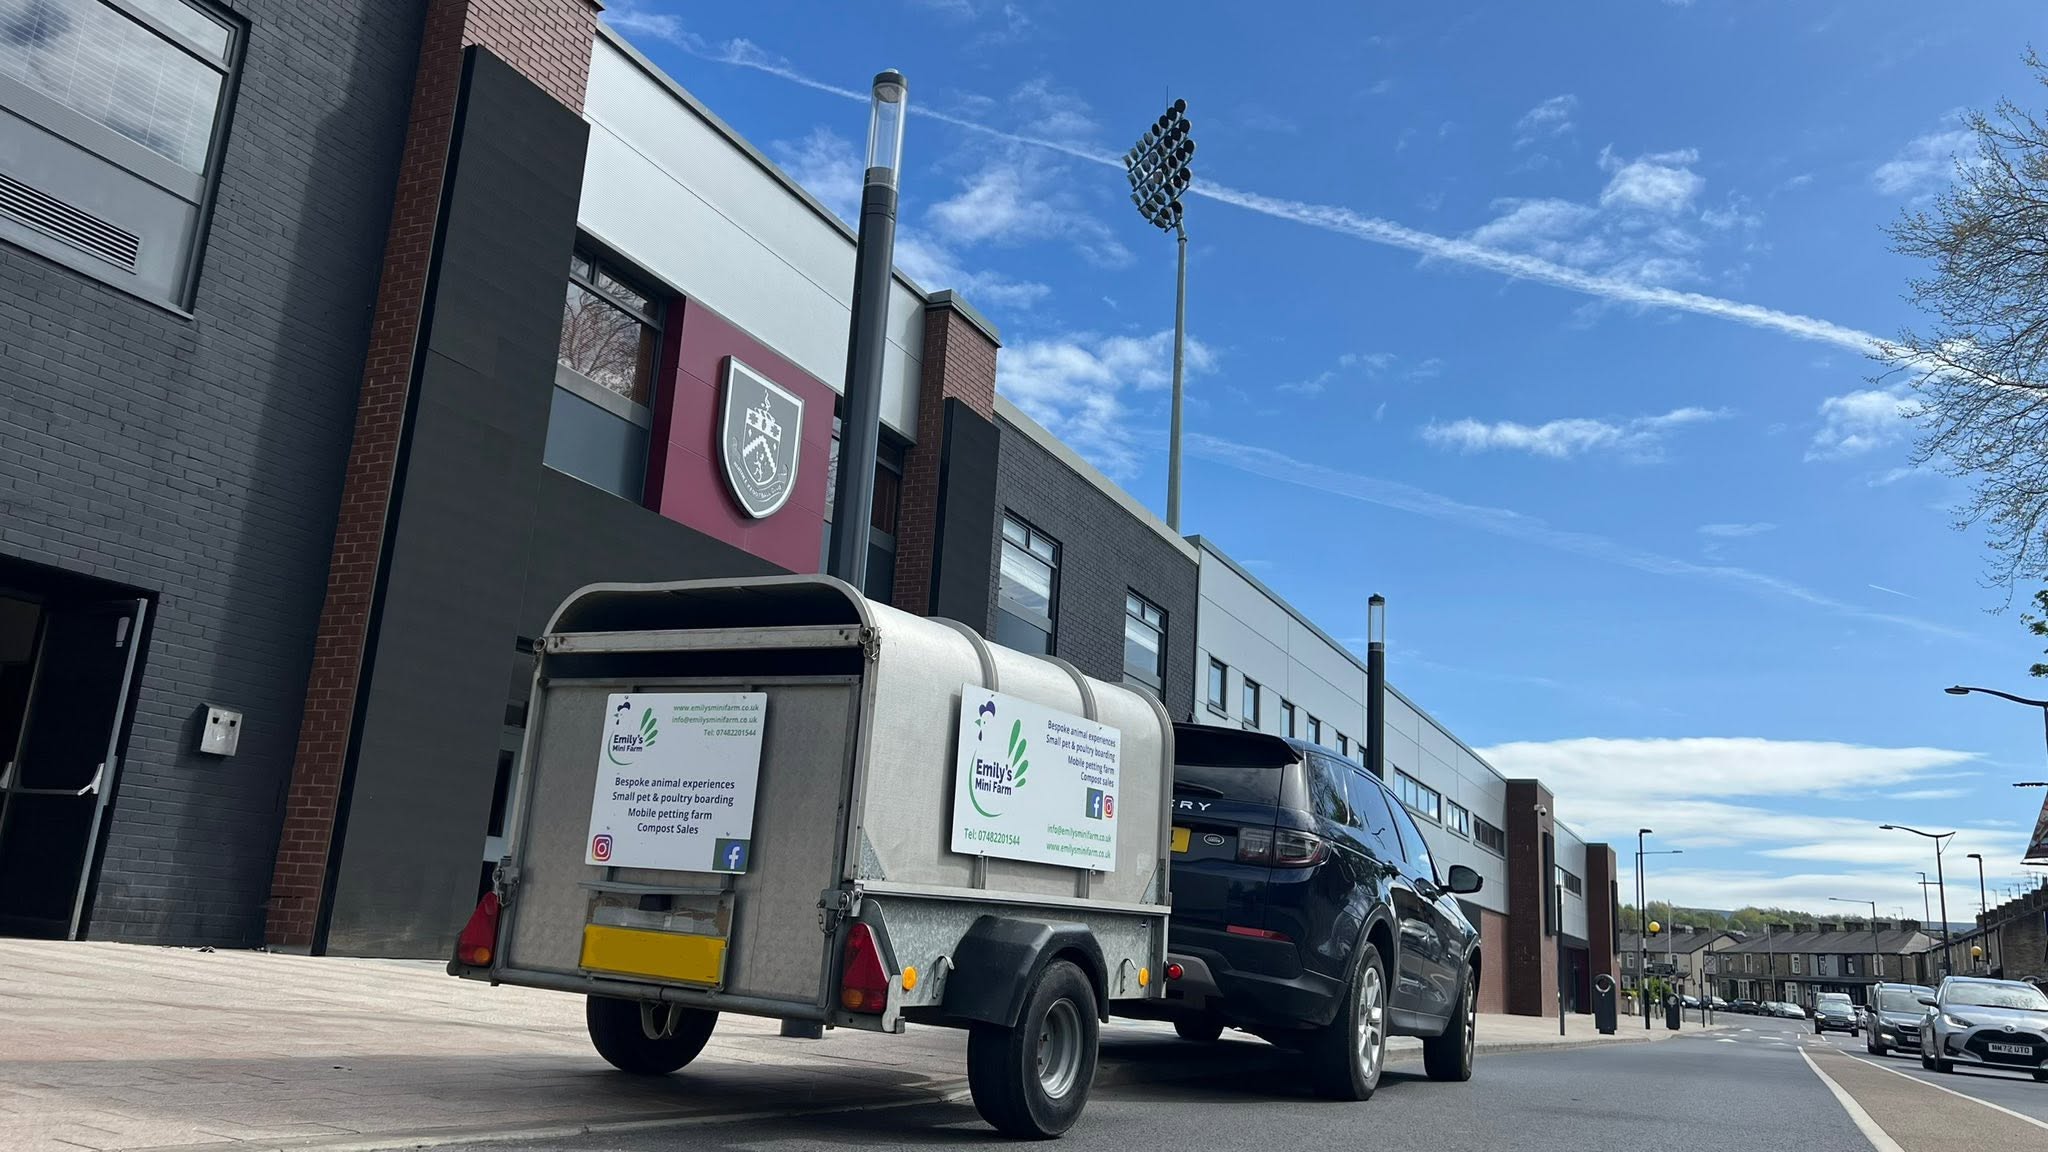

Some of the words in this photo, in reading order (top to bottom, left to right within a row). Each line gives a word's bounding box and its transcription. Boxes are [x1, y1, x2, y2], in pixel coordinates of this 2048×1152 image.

[673, 704, 759, 713] www.emilysminifarm.co.uk
[672, 715, 758, 725] info@emilysminifarm.co.uk
[613, 734, 643, 746] Emily's
[704, 729, 715, 737] Tel:
[716, 729, 757, 737] 07482201544
[1048, 719, 1070, 734] Bespoke
[1071, 727, 1088, 739] animal
[1088, 733, 1116, 748] experiences
[626, 745, 643, 753] Farm
[1046, 733, 1061, 746] Small
[1062, 740, 1071, 750] pet
[1071, 740, 1076, 750] &
[1076, 743, 1094, 757] poultry
[1095, 747, 1116, 763] boarding
[976, 758, 1012, 784] Emily's
[1068, 755, 1085, 768] Mobile
[1085, 761, 1103, 775] petting
[1103, 763, 1115, 775] farm
[615, 777, 650, 788] Bespoke
[651, 778, 681, 788] animal
[682, 779, 735, 790] experiences
[975, 777, 992, 792] Mini
[992, 781, 1012, 796] Farm
[1080, 771, 1102, 786] Compost
[1102, 776, 1114, 788] sales
[612, 791, 635, 801] Small
[636, 792, 651, 804] pet
[652, 793, 660, 802] &
[661, 793, 693, 805] poultry
[694, 794, 735, 807] boarding
[628, 808, 656, 818] Mobile
[657, 809, 690, 821] petting
[691, 810, 713, 820] farm
[637, 822, 675, 834] Compost
[676, 824, 699, 835] Sales
[964, 828, 977, 841] Tel:
[977, 829, 1020, 846] 07482201544
